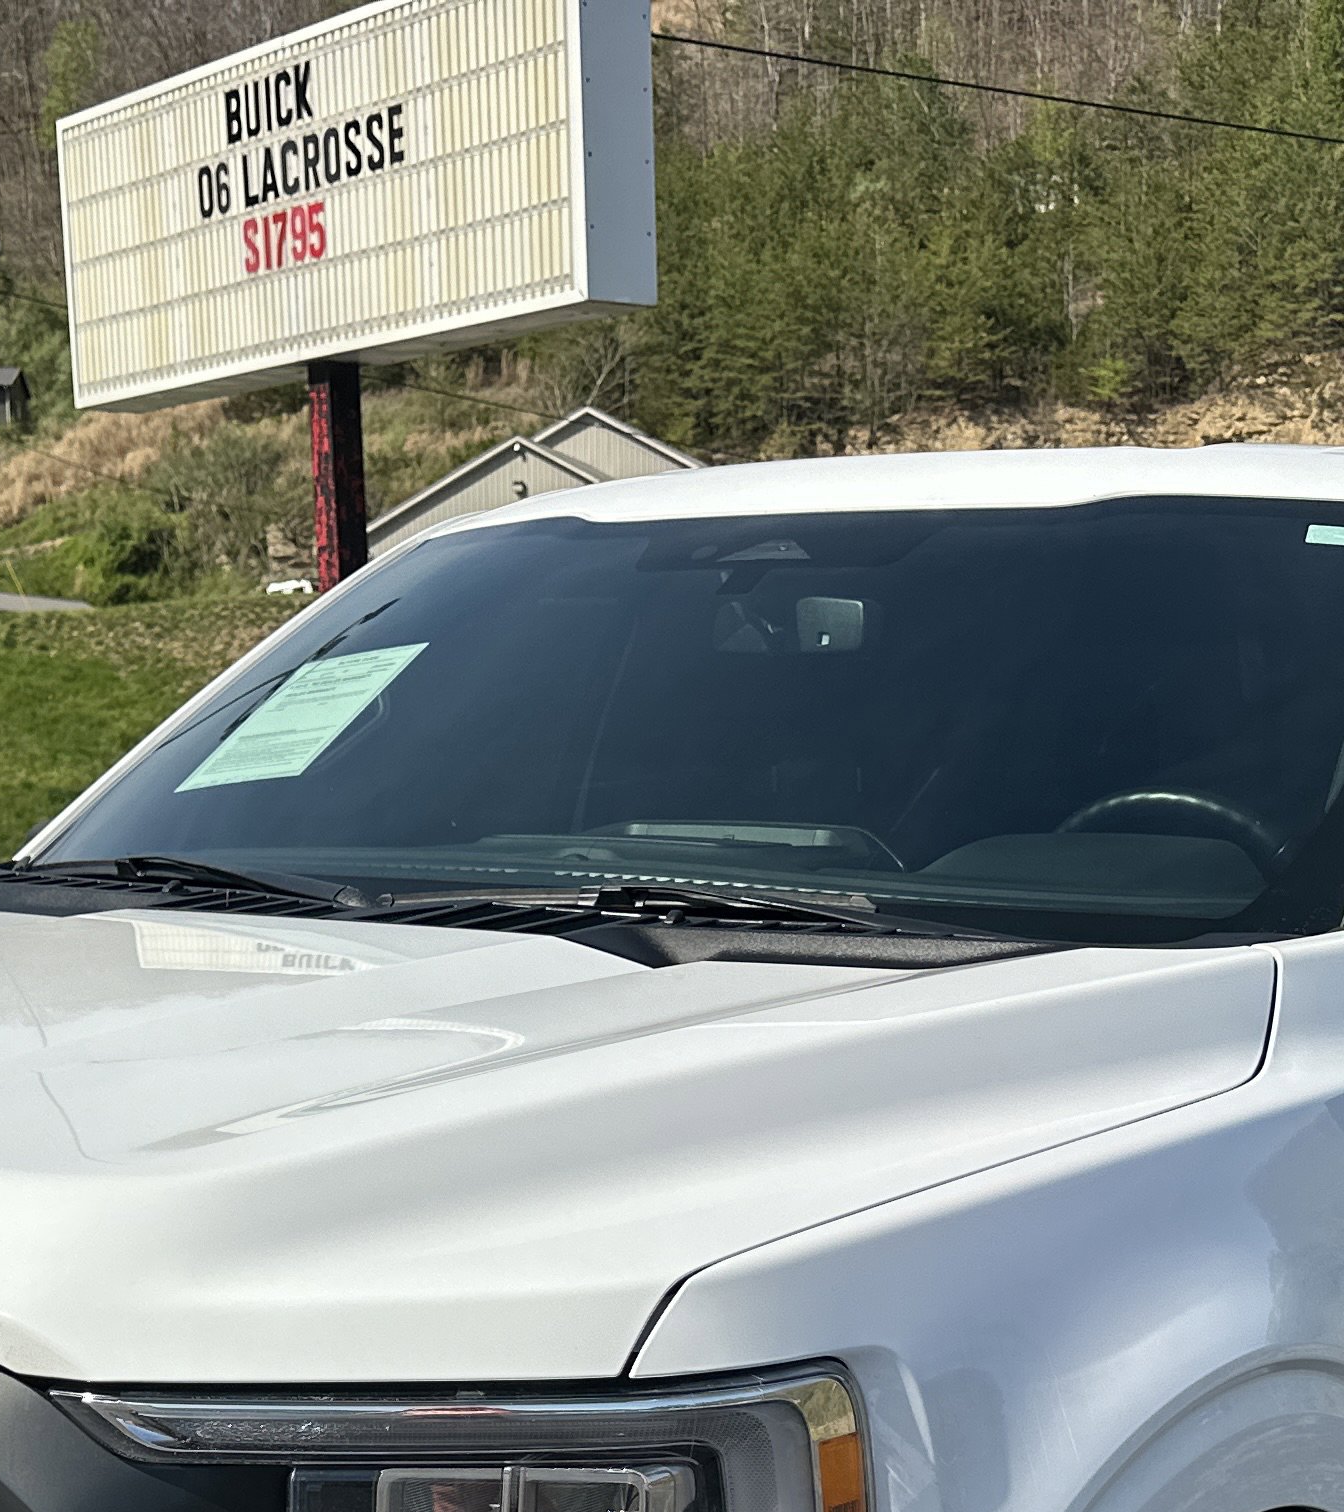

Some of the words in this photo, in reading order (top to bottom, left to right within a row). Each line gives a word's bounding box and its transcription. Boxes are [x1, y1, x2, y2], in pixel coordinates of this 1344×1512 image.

[225, 60, 313, 144] BUICK
[198, 162, 232, 219] 06
[242, 103, 405, 209] LACROSSE
